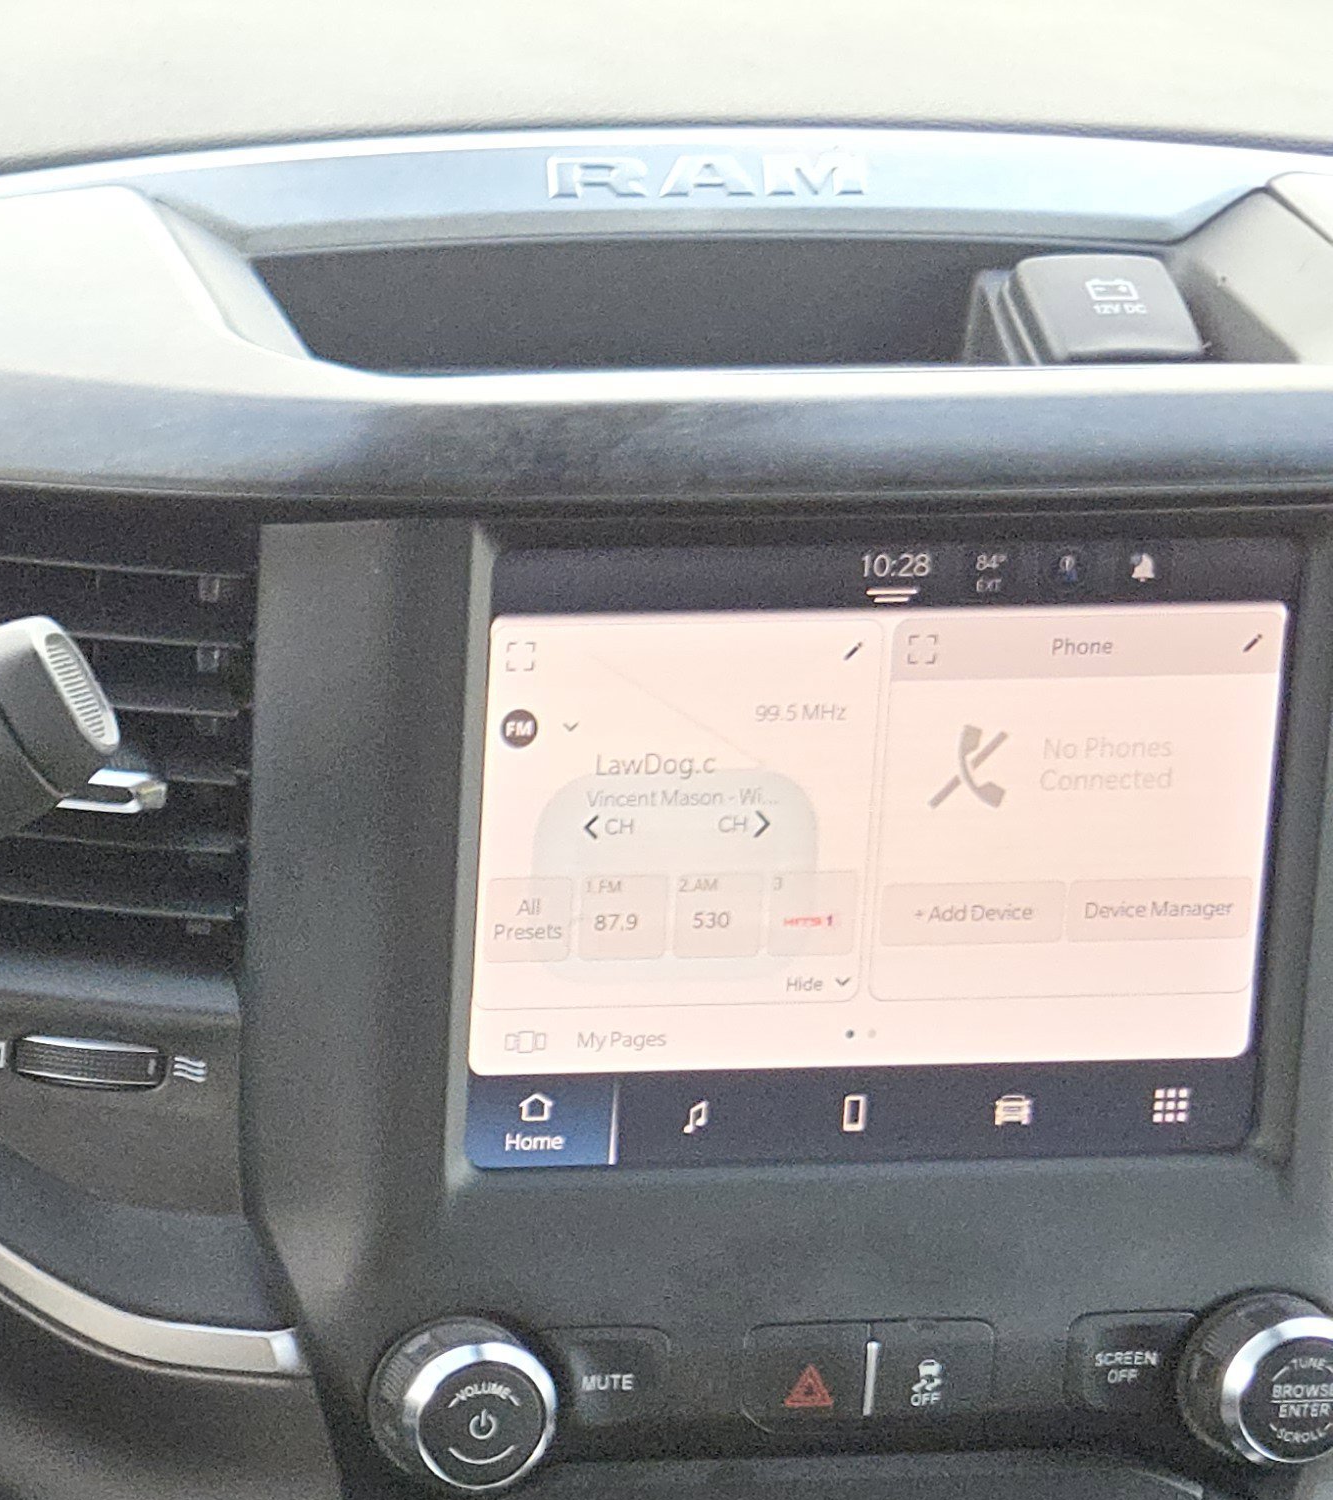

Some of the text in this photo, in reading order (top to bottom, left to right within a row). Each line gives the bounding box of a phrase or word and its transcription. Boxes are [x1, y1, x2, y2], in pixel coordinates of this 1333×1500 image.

[547, 154, 866, 198] RAM
[1093, 303, 1148, 315] 12V DC
[861, 553, 931, 578] 10:28
[975, 577, 1002, 592] EXT
[1051, 637, 1114, 656] Phone
[754, 703, 847, 722] 99.5 MHz
[505, 720, 533, 737] FM
[1043, 736, 1172, 759] No Phones
[595, 752, 716, 779] LawDog.c
[1039, 768, 1173, 792] Connected
[586, 790, 658, 807] Vincent
[661, 789, 724, 807] Mason
[605, 818, 634, 835] CH
[718, 816, 747, 833] CH
[516, 898, 541, 916] All
[928, 904, 967, 922] Add
[973, 903, 1034, 922] Device
[1084, 899, 1235, 920] Device Manager
[594, 913, 638, 931] 87.9
[692, 911, 730, 929] 530
[493, 922, 563, 940] Presets
[785, 975, 823, 992] Hide
[577, 1030, 667, 1051] My Pages
[505, 1133, 564, 1152] Home
[1095, 1351, 1158, 1367] SCREEN
[1290, 1357, 1327, 1371] TUNE
[581, 1374, 633, 1392] MUTE
[1107, 1368, 1138, 1385] OFF
[455, 1382, 513, 1401] VOLUME
[910, 1392, 942, 1407] OFF
[1278, 1402, 1331, 1418] ENTER
[1276, 1428, 1327, 1443] SCROLL
